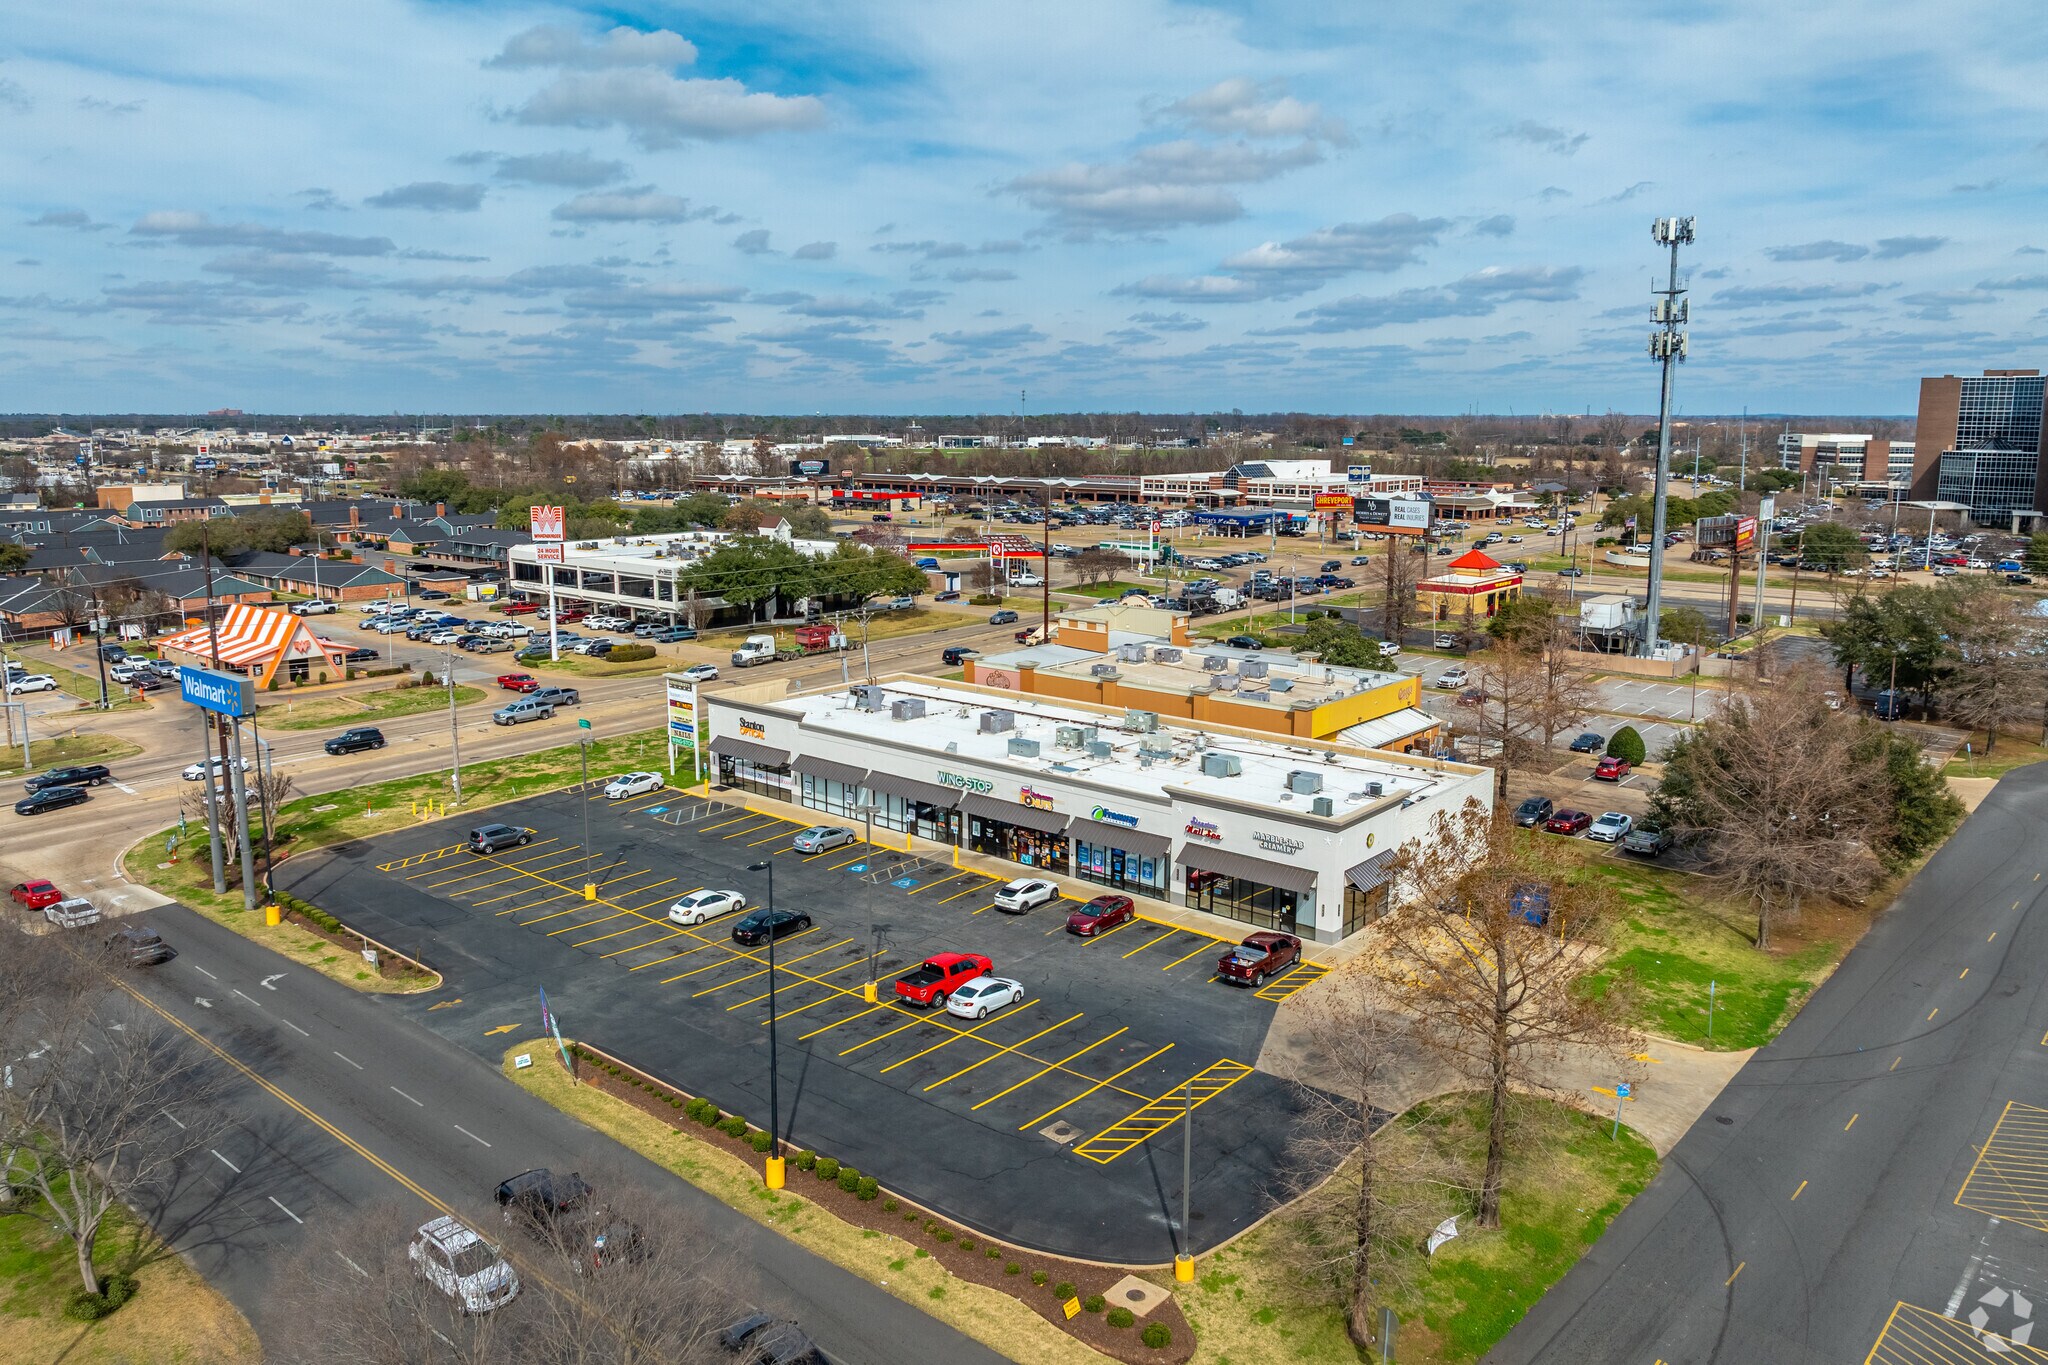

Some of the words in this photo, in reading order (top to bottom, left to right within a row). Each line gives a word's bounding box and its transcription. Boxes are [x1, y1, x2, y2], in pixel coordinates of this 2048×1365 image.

[1316, 496, 1353, 505] SHREVEPORT
[183, 675, 226, 705] Walmart
[739, 717, 765, 733] Stanton
[740, 727, 765, 740] OPTICAL
[1185, 825, 1204, 837] Nail
[1206, 830, 1223, 841] Spa
[1253, 831, 1284, 844] MARBLE
[1284, 838, 1305, 850] SLAB
[1259, 841, 1296, 855] CREAMERY
